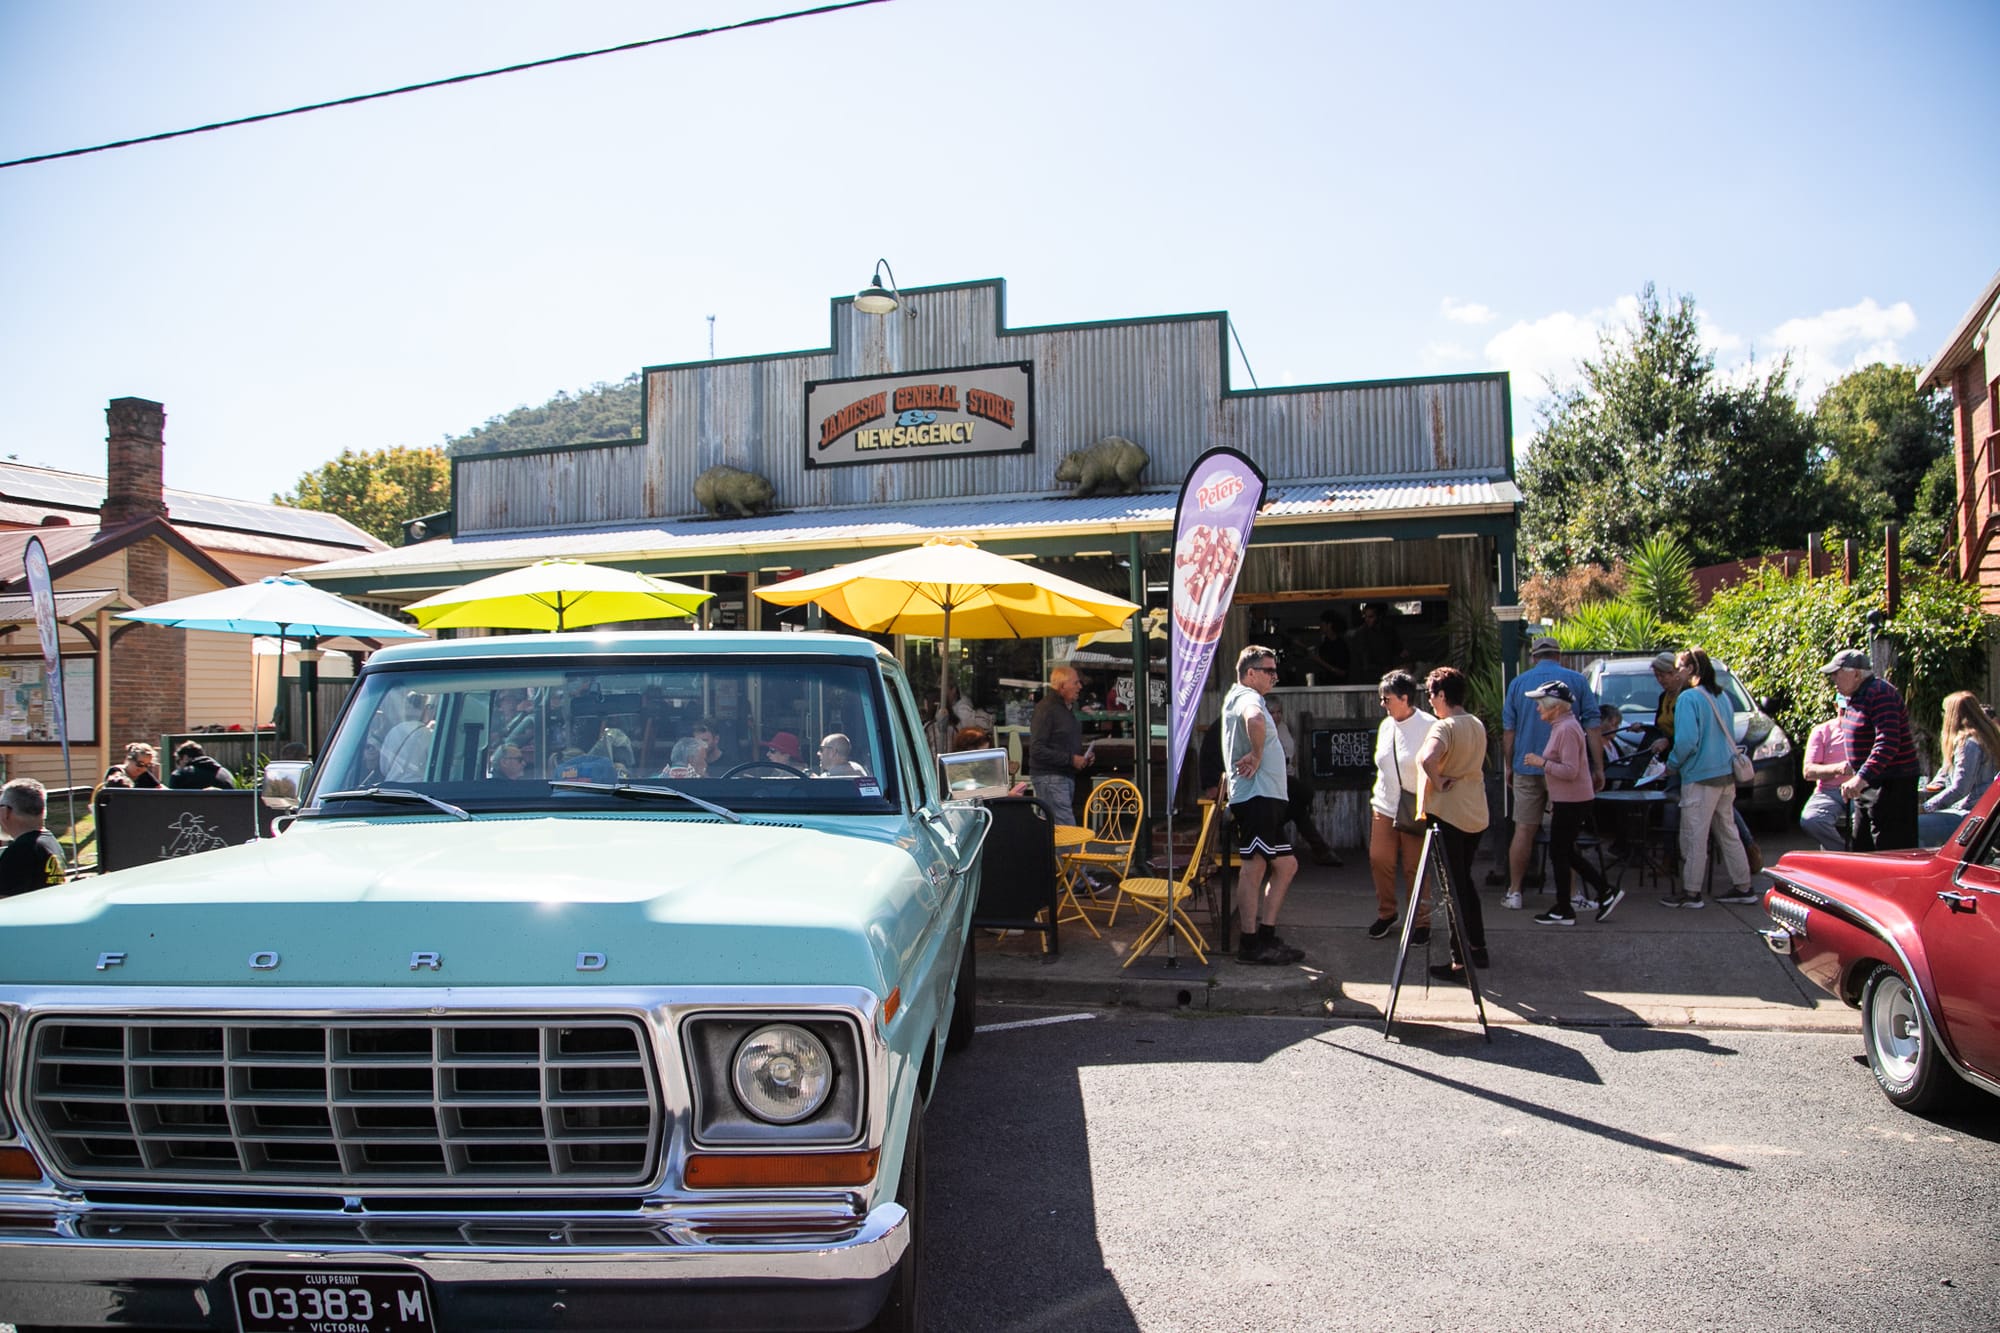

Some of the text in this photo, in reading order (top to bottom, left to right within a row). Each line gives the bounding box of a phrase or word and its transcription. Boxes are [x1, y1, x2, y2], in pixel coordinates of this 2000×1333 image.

[819, 384, 1015, 448] JAMIESON GENERAL STORE
[897, 409, 937, 427] &
[856, 421, 975, 450] NEWSAGENCY
[1196, 475, 1243, 512] Peters
[1331, 731, 1369, 745] ORDER
[1331, 744, 1369, 754] INSIDE
[1332, 754, 1371, 767] PLEASE
[96, 951, 608, 971] FORD
[305, 1275, 360, 1285] CLUB PERMIT
[248, 1287, 374, 1321] 03383
[310, 1322, 370, 1333] VICTORIA
